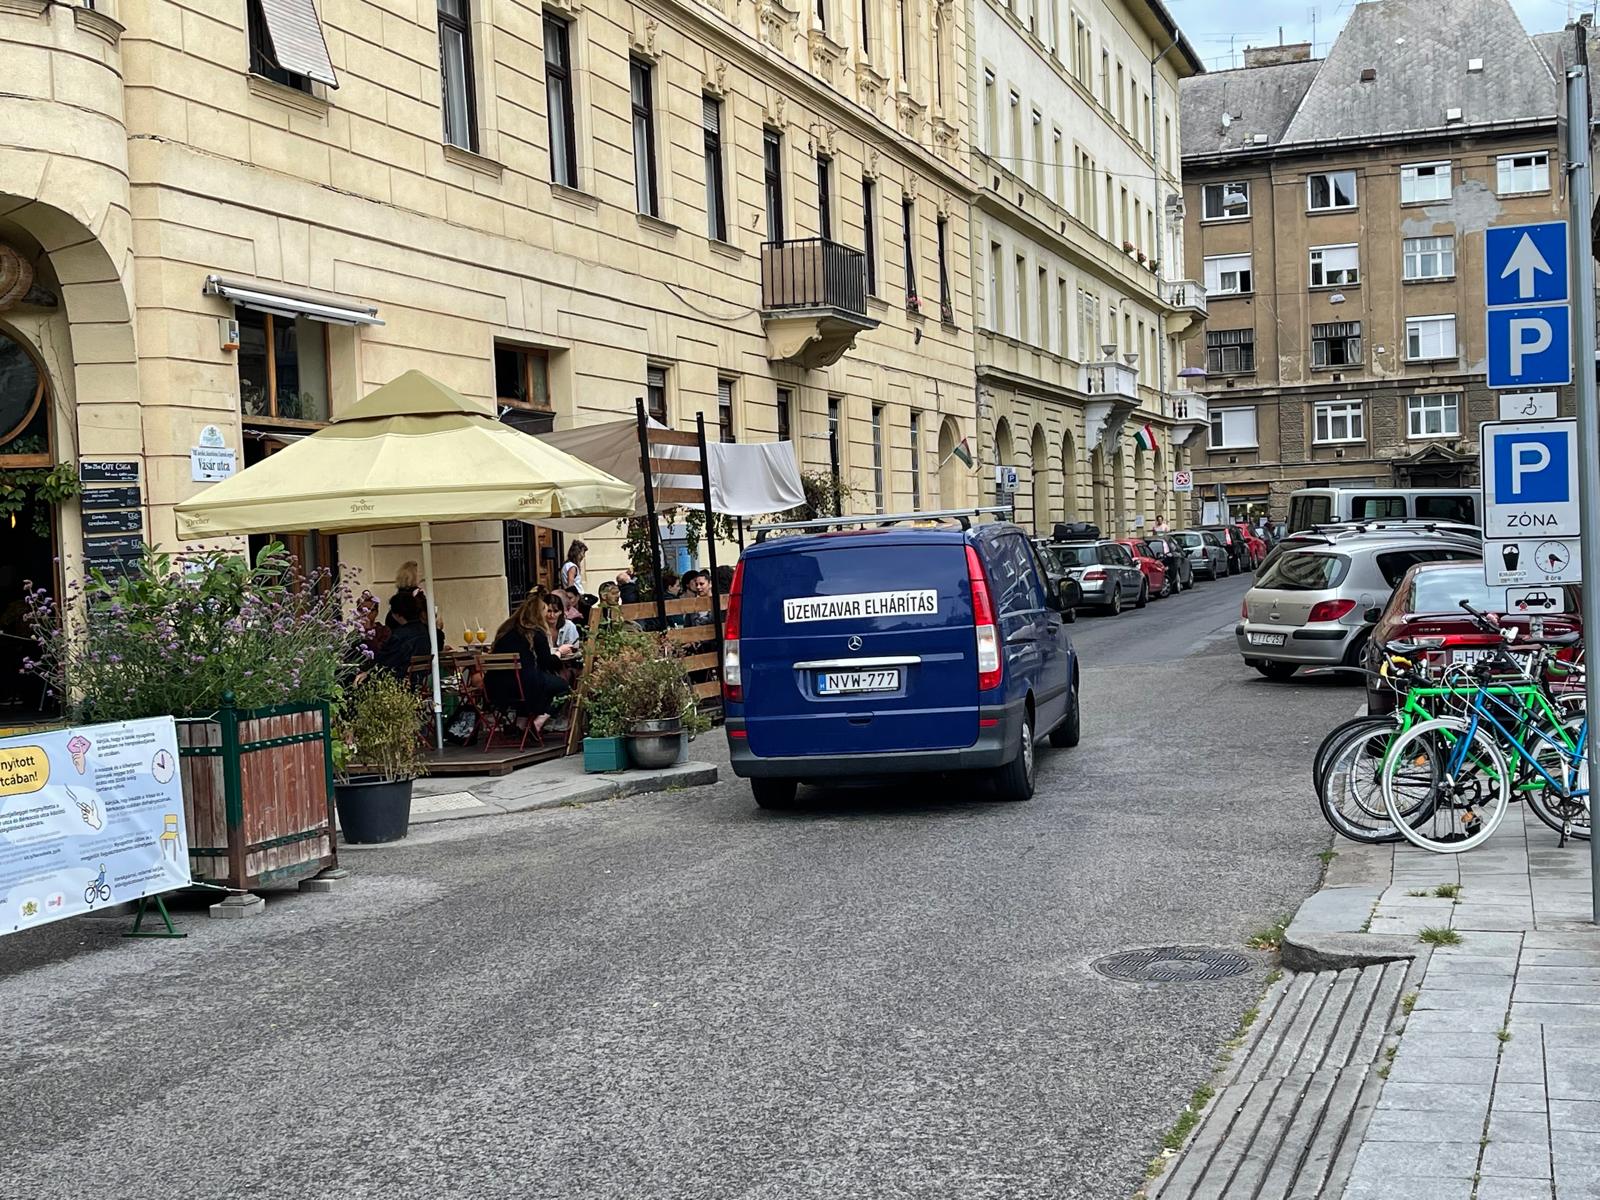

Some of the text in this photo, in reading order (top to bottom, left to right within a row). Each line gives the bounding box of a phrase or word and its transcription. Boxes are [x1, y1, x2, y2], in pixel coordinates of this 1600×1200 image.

[1509, 317, 1553, 377] P
[198, 457, 231, 471] Vásár utca
[1511, 441, 1551, 495] P
[350, 503, 375, 513] Dreher
[518, 497, 544, 506] Dreher
[185, 516, 210, 528] Dreher
[1507, 511, 1559, 528] ZÓNA
[786, 592, 935, 621] ÜZEMZAVAR ELHÁRÍTÁS
[828, 672, 895, 689] NVW-777
[0, 755, 36, 772] nyitott
[0, 771, 39, 787] tcában!
